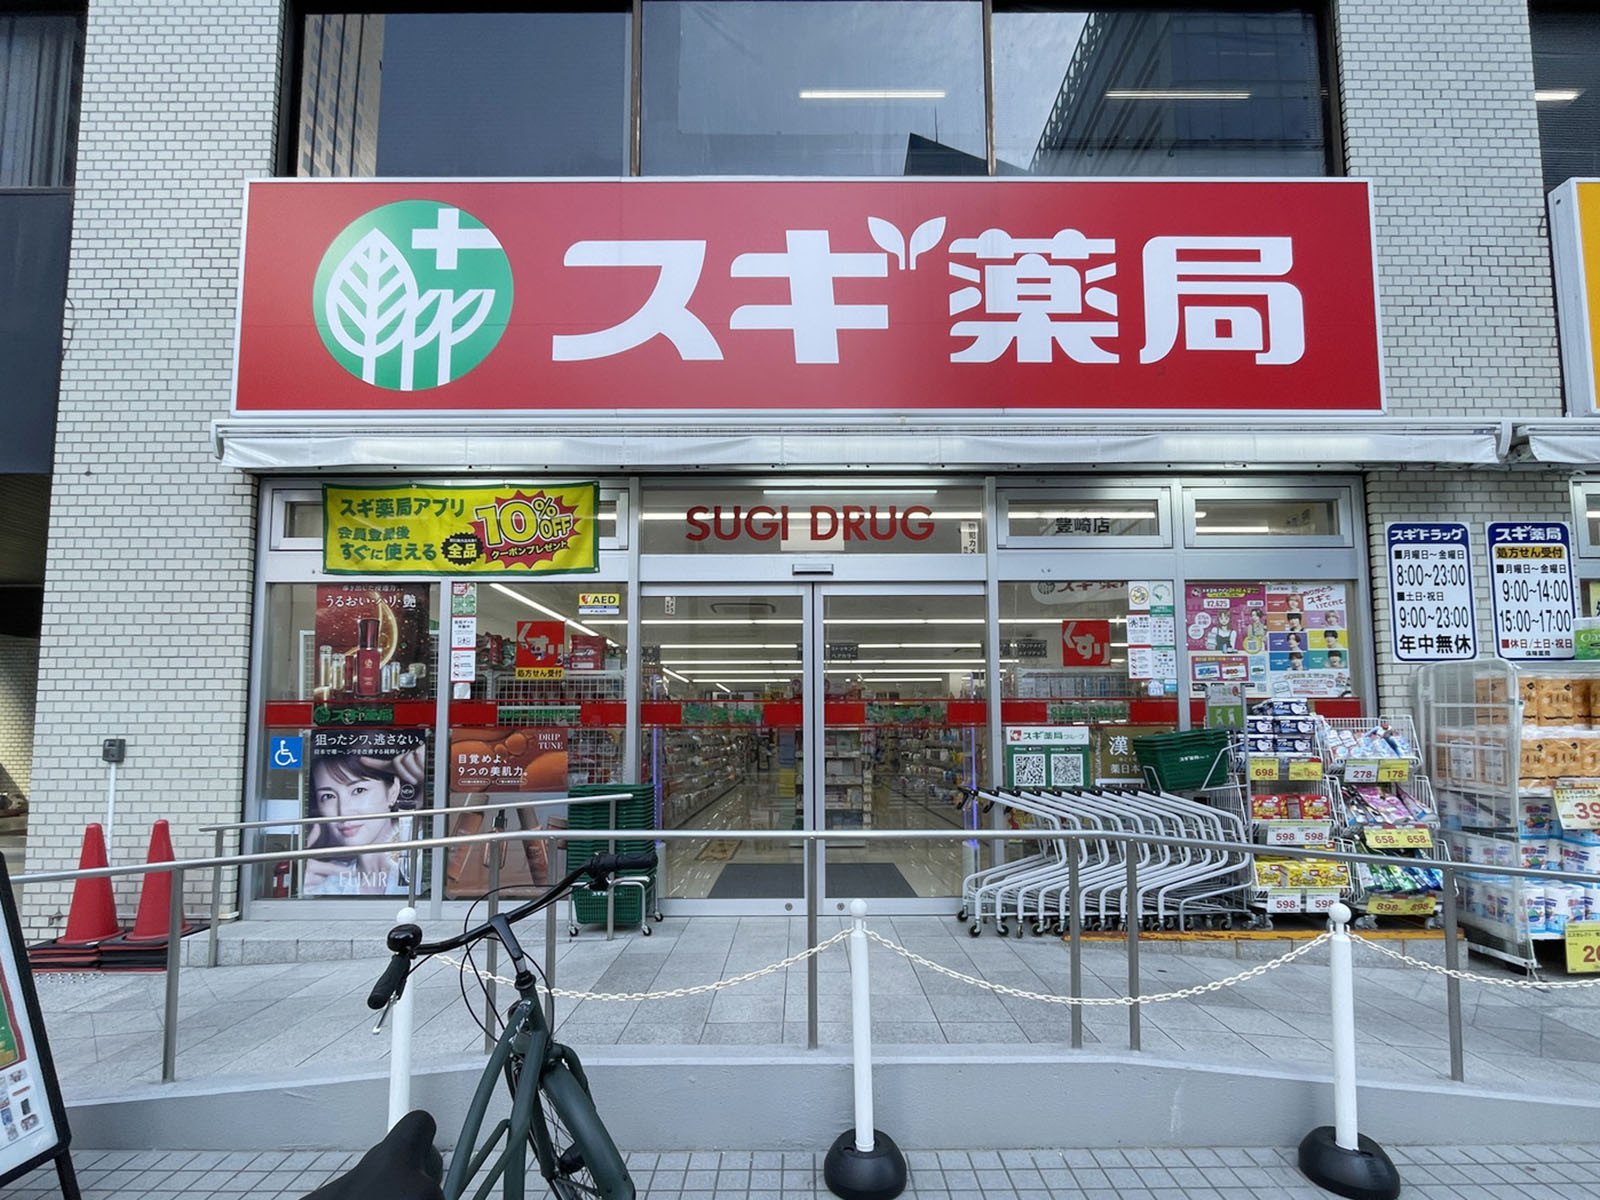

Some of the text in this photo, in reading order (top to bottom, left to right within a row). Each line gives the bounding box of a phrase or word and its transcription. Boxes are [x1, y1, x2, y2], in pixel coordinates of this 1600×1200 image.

[551, 216, 1306, 365] スギ薬局
[339, 495, 465, 518] スギ薬局アプリ
[686, 505, 935, 541] SUGI DRUG
[1055, 517, 1111, 534] 豊崎店
[338, 526, 411, 541] 会員登録後
[1391, 527, 1465, 541] スギドラッグ
[1495, 525, 1562, 541] スギ薬局
[339, 542, 438, 562] すぐに使える
[447, 543, 477, 559] 全品
[491, 540, 569, 560] クーポンプレゼント
[1496, 547, 1564, 559] 処方せん受付
[592, 595, 616, 605] AED
[1399, 634, 1472, 654] 年中無休
[517, 669, 563, 678] 処方せん受付
[315, 733, 424, 746] 狙ったシワ、逃さない。
[539, 733, 561, 741] DRIP
[539, 742, 564, 750] TUNE
[458, 754, 507, 764] 目覚めよ、
[458, 766, 528, 777] 9つの美肌力。
[1255, 768, 1274, 776] 698
[1353, 770, 1372, 778] 278
[1387, 770, 1404, 778] 178
[1275, 833, 1295, 841] 598
[1304, 832, 1324, 840] 598
[1375, 836, 1394, 844] 658
[1407, 836, 1426, 844] 658
[1276, 900, 1296, 909] 598
